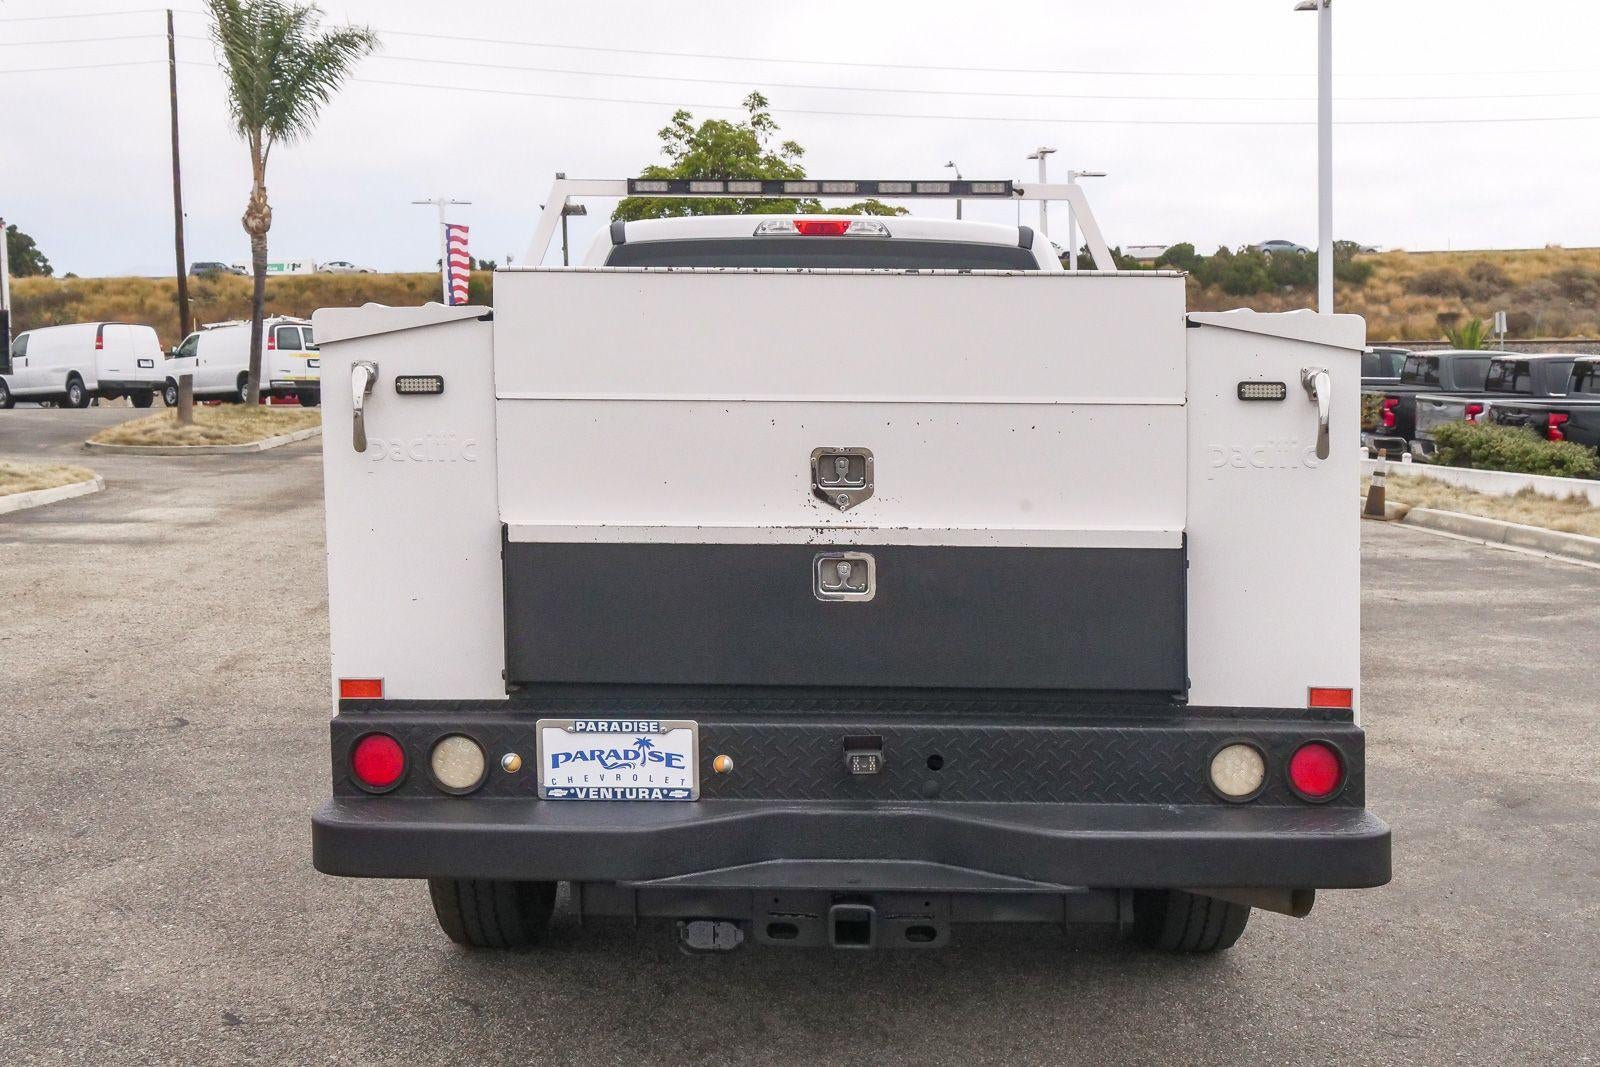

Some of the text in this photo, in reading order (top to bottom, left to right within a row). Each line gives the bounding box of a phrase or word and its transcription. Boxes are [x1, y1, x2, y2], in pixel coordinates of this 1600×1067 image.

[366, 432, 479, 474] pacific
[575, 721, 659, 732] PARADISE
[551, 737, 686, 770] PARADISE
[551, 774, 686, 786] CHEVROLET
[574, 788, 664, 800] VENTURA
